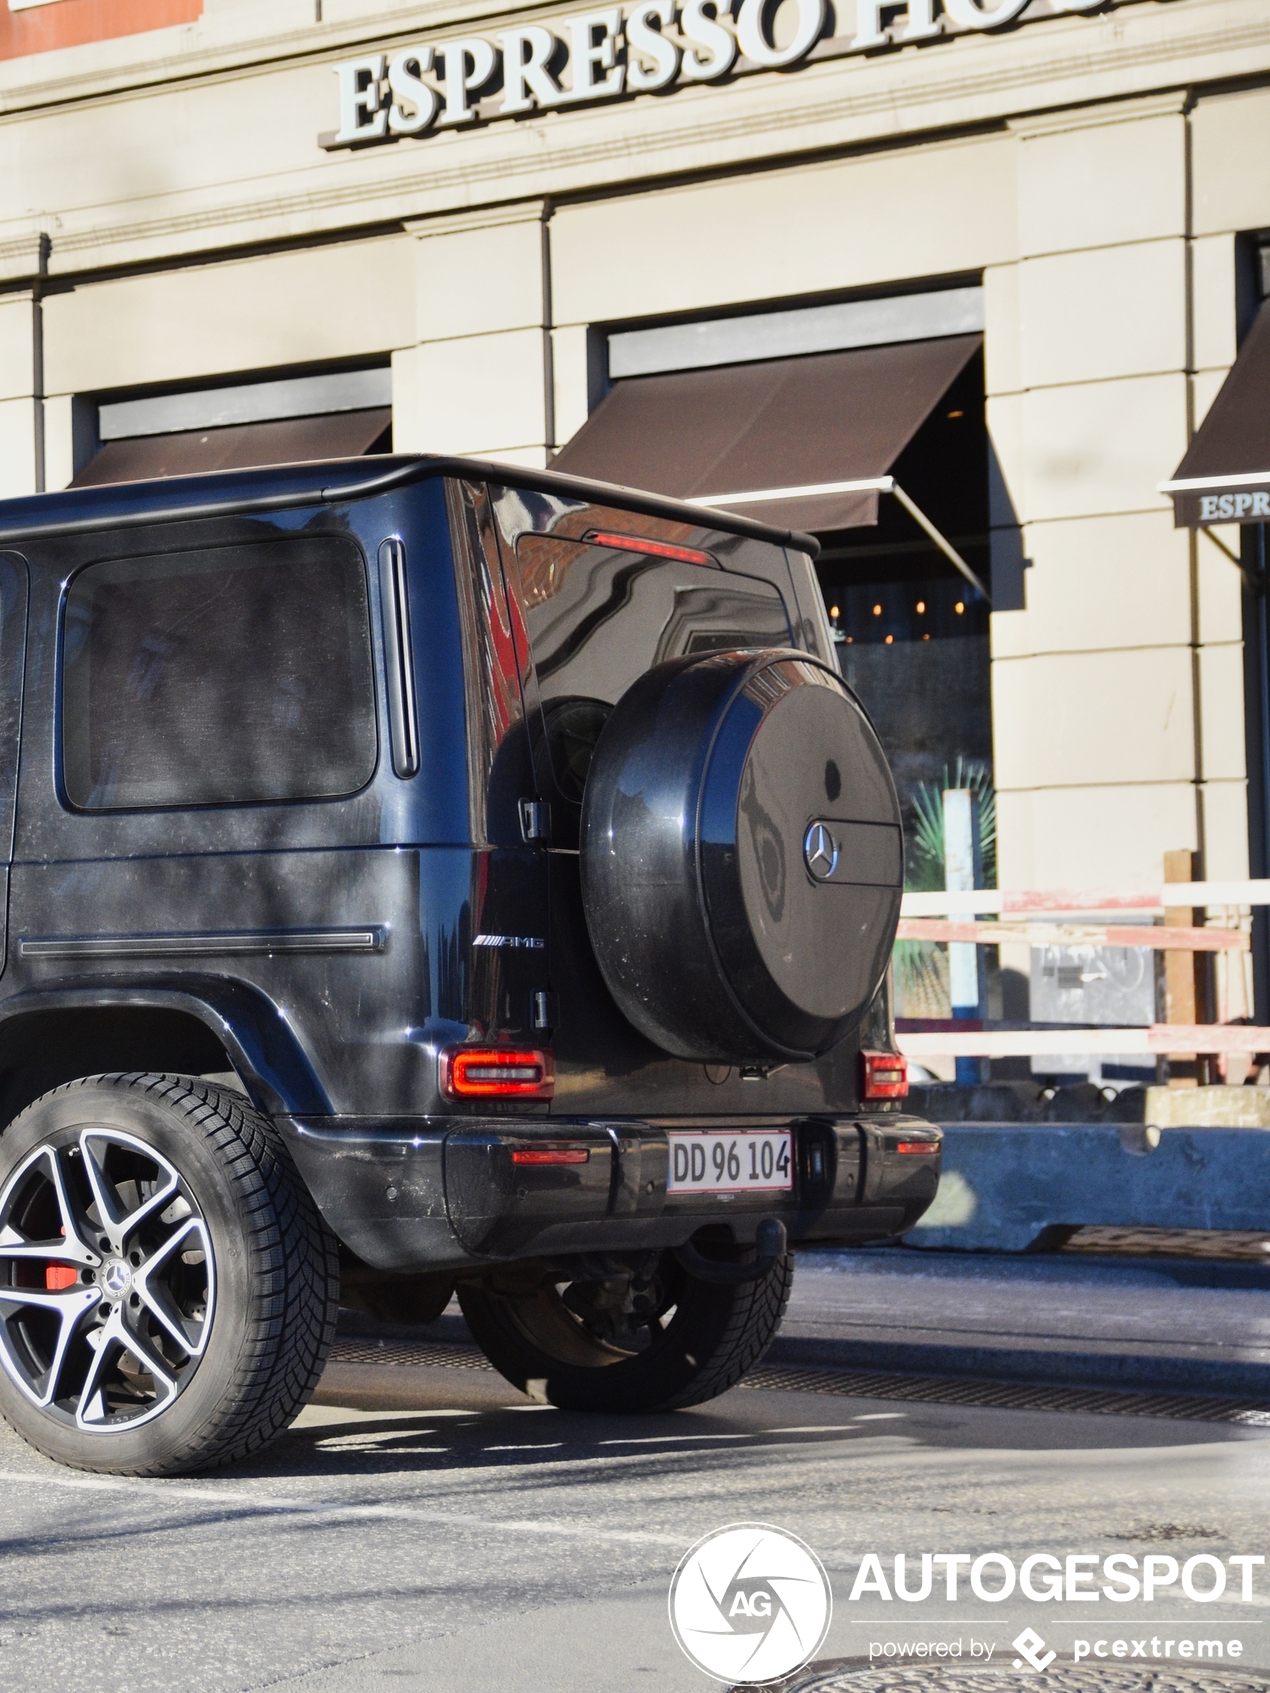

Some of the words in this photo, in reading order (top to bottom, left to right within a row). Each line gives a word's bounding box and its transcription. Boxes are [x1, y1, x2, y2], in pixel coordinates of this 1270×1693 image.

[332, 0, 822, 142] ESPRESSO
[673, 1142, 706, 1183] DD
[711, 1140, 741, 1183] 96
[748, 1139, 789, 1180] 104
